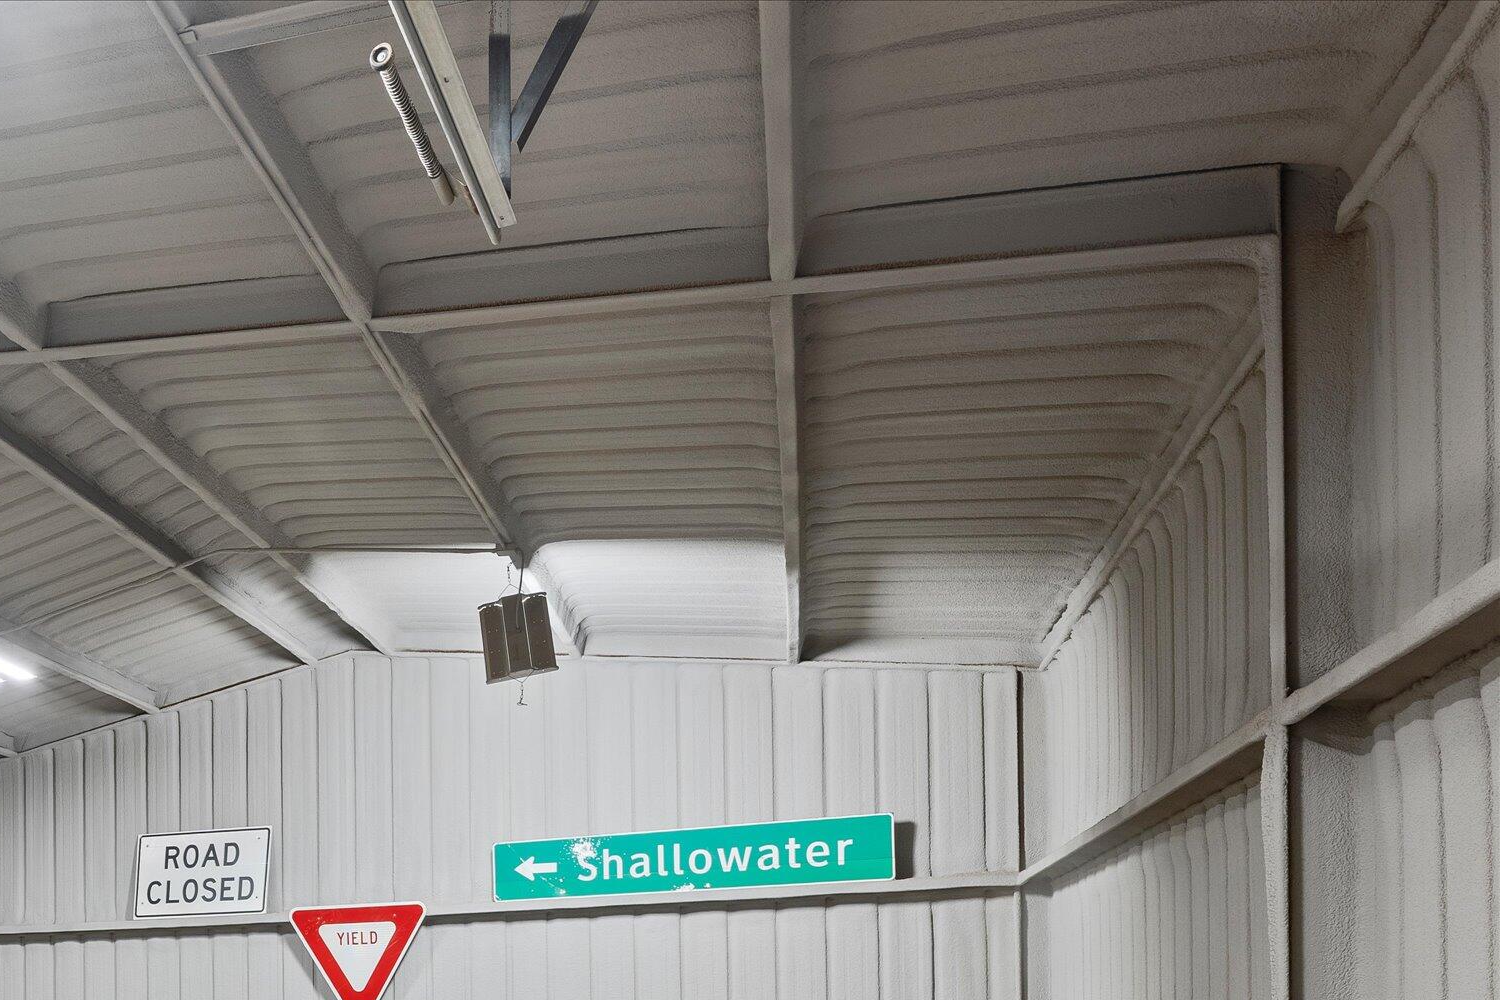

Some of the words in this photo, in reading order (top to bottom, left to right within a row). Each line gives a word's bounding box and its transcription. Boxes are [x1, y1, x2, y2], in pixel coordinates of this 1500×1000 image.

[164, 842, 240, 869] ROAD
[577, 837, 853, 881] Shallowater
[147, 876, 254, 904] CLOSED
[337, 931, 378, 945] YIELD
